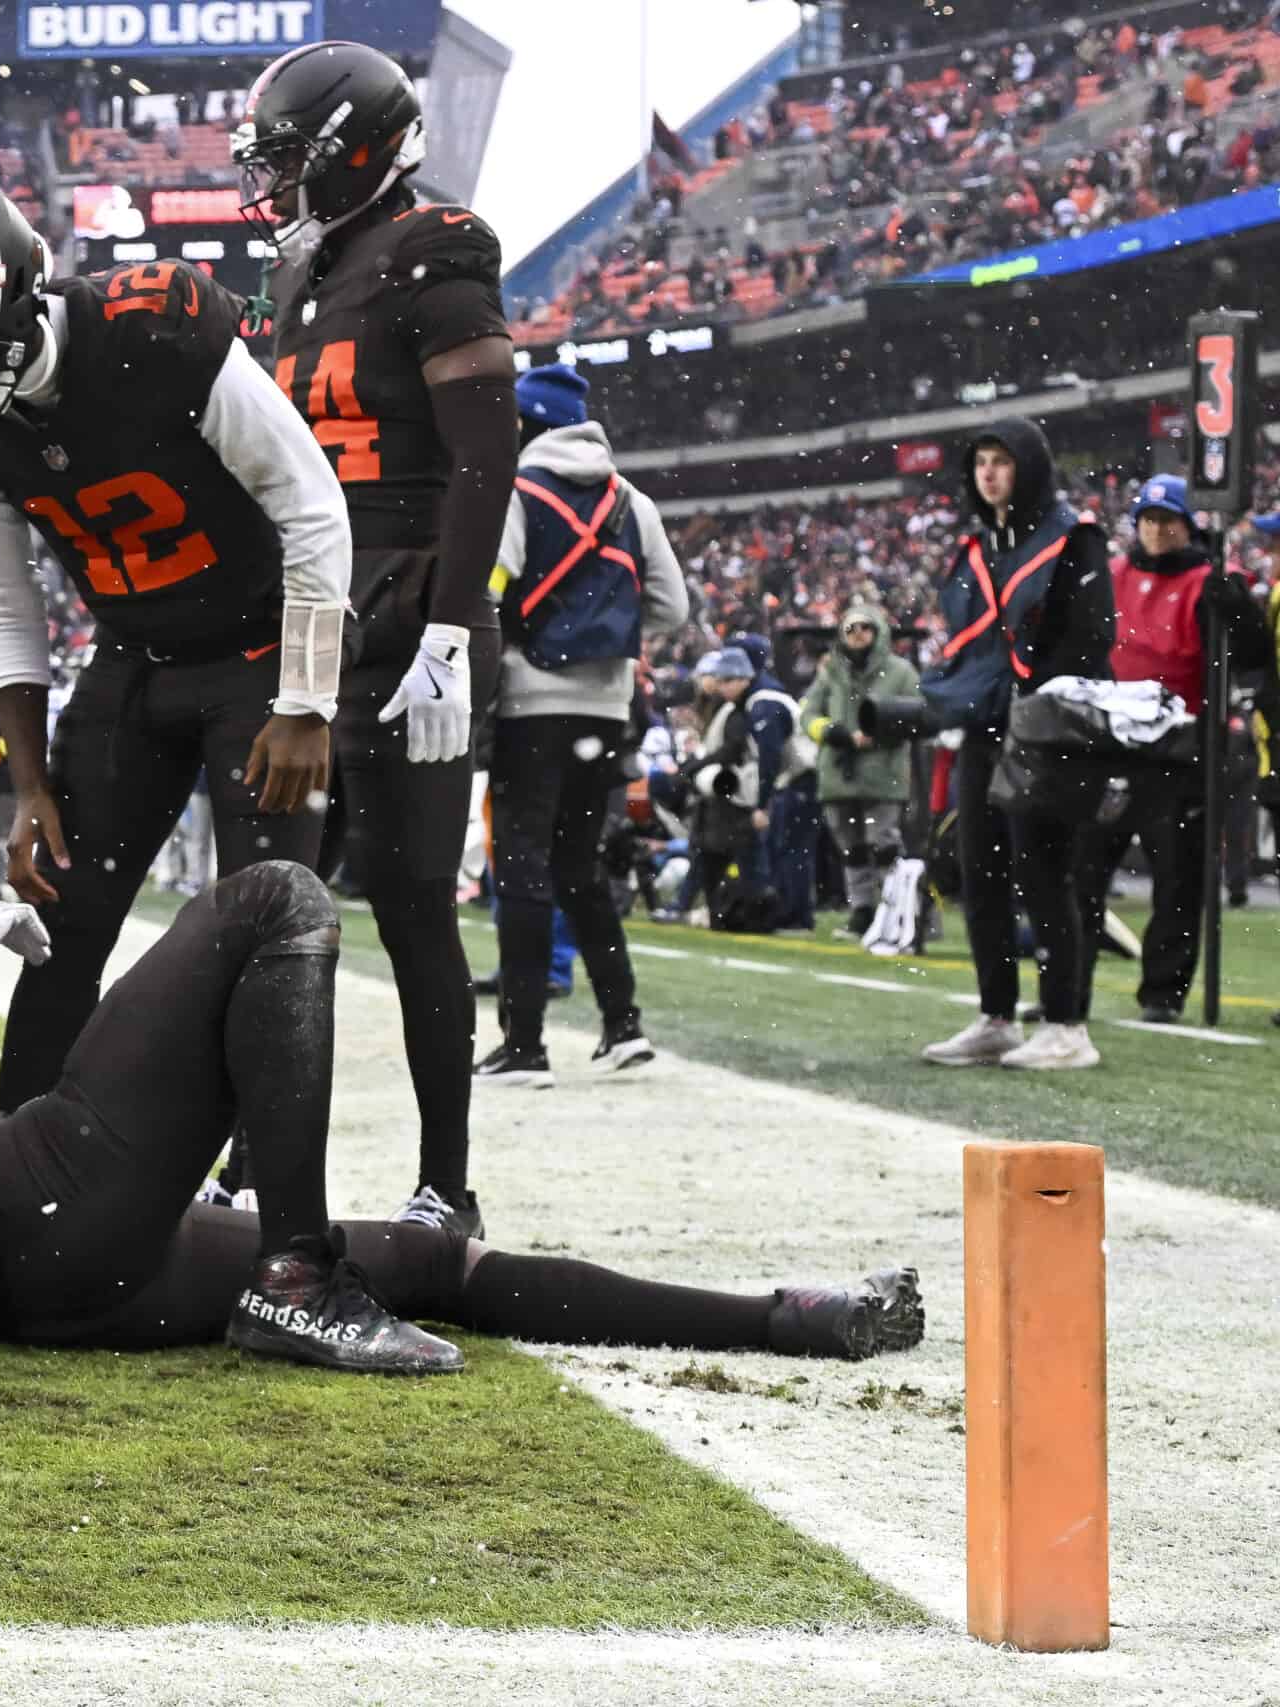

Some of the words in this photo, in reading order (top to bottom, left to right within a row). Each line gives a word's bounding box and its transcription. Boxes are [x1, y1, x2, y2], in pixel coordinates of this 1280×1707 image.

[28, 4, 145, 47] BUD
[150, 1, 312, 44] LIGHT
[103, 263, 177, 321] 12
[1196, 335, 1234, 438] 3
[25, 471, 217, 595] 12
